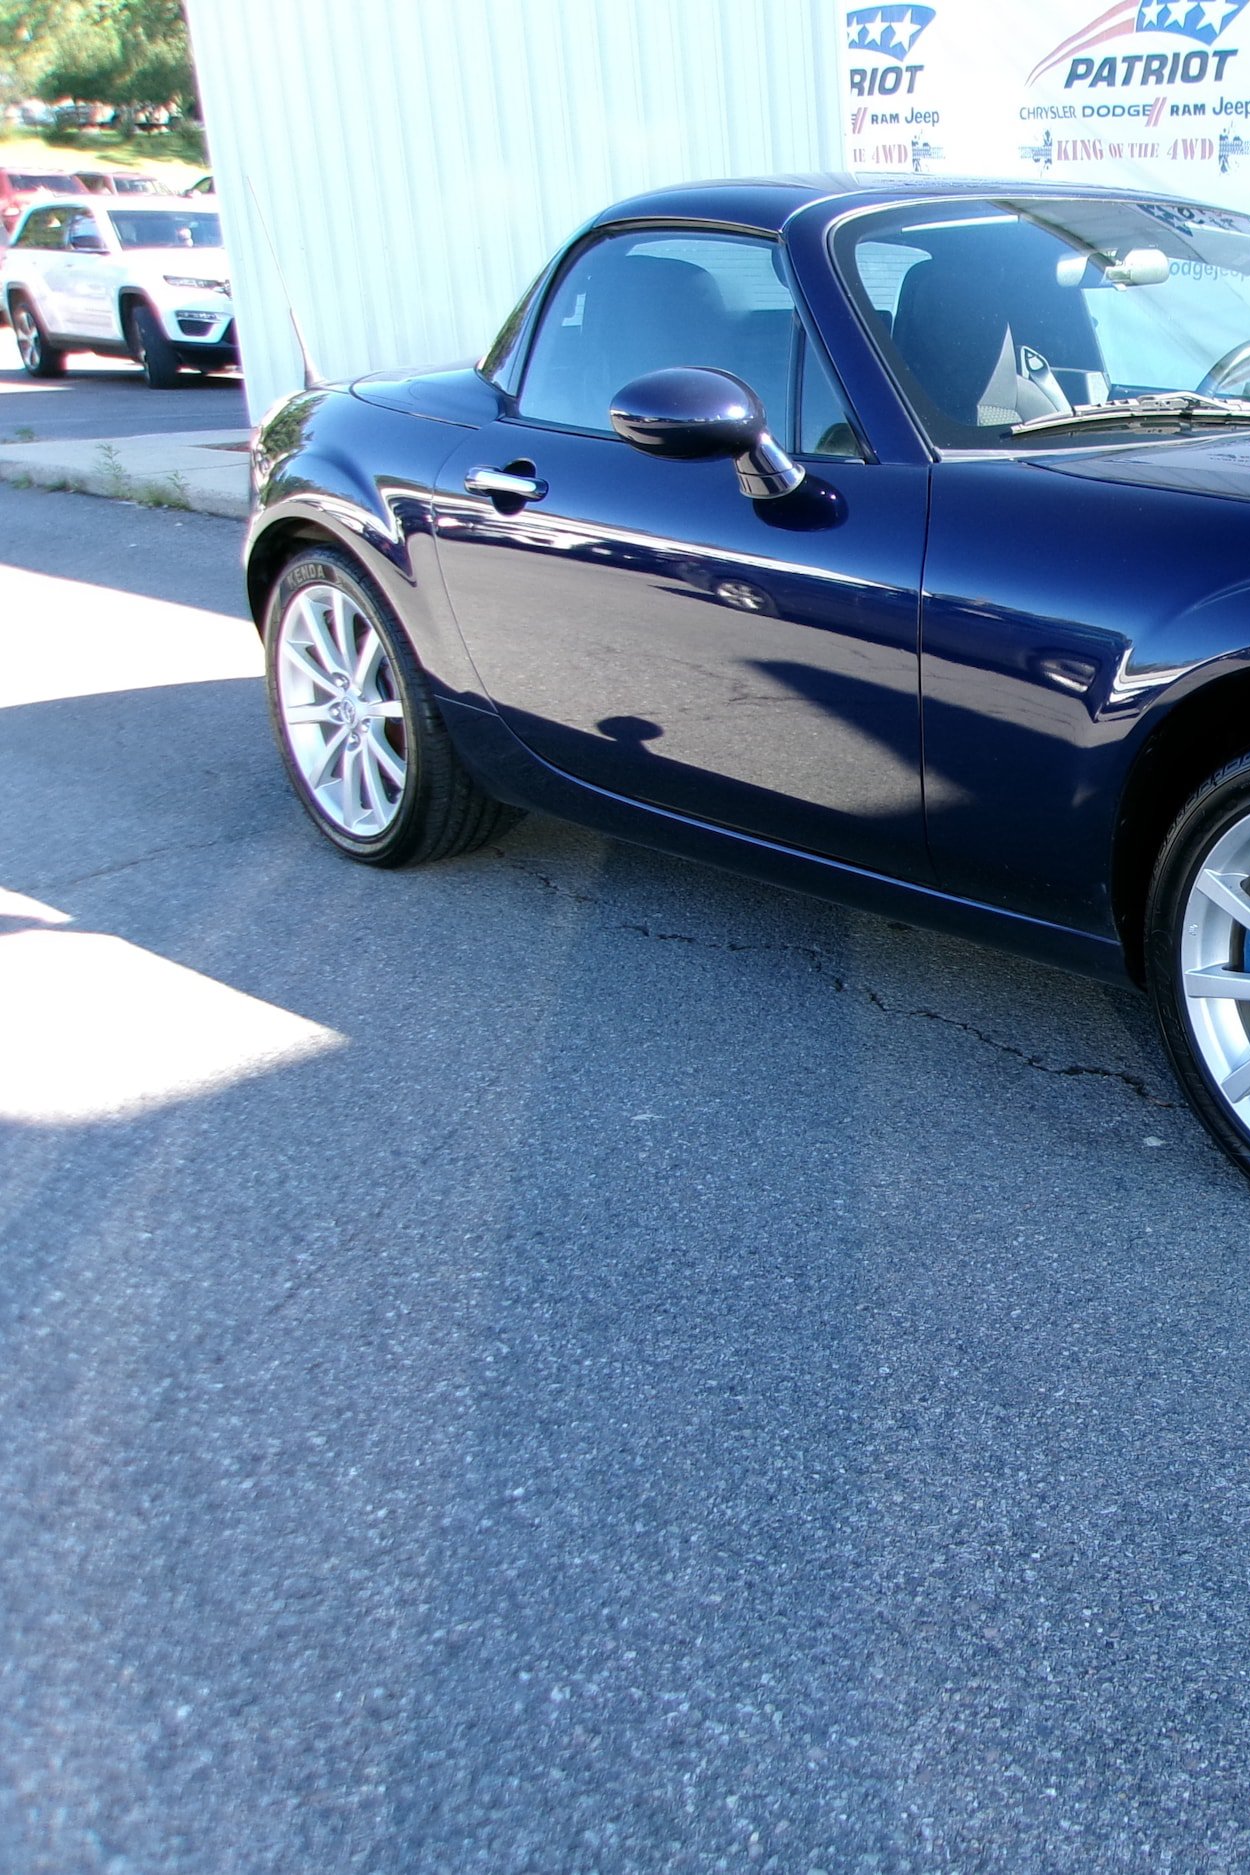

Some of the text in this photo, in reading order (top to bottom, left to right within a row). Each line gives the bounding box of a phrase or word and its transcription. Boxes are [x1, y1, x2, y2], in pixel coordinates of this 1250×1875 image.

[1064, 49, 1238, 89] PATRIOT
[871, 106, 940, 127] RAM Jeep
[1019, 104, 1077, 120] CHRYSLER
[1082, 104, 1153, 118] DODGE
[1170, 103, 1206, 117] RAM
[867, 144, 909, 164] 4WD
[1056, 138, 1214, 161] KING OF THE 4WD
[286, 564, 326, 591] KENDA
